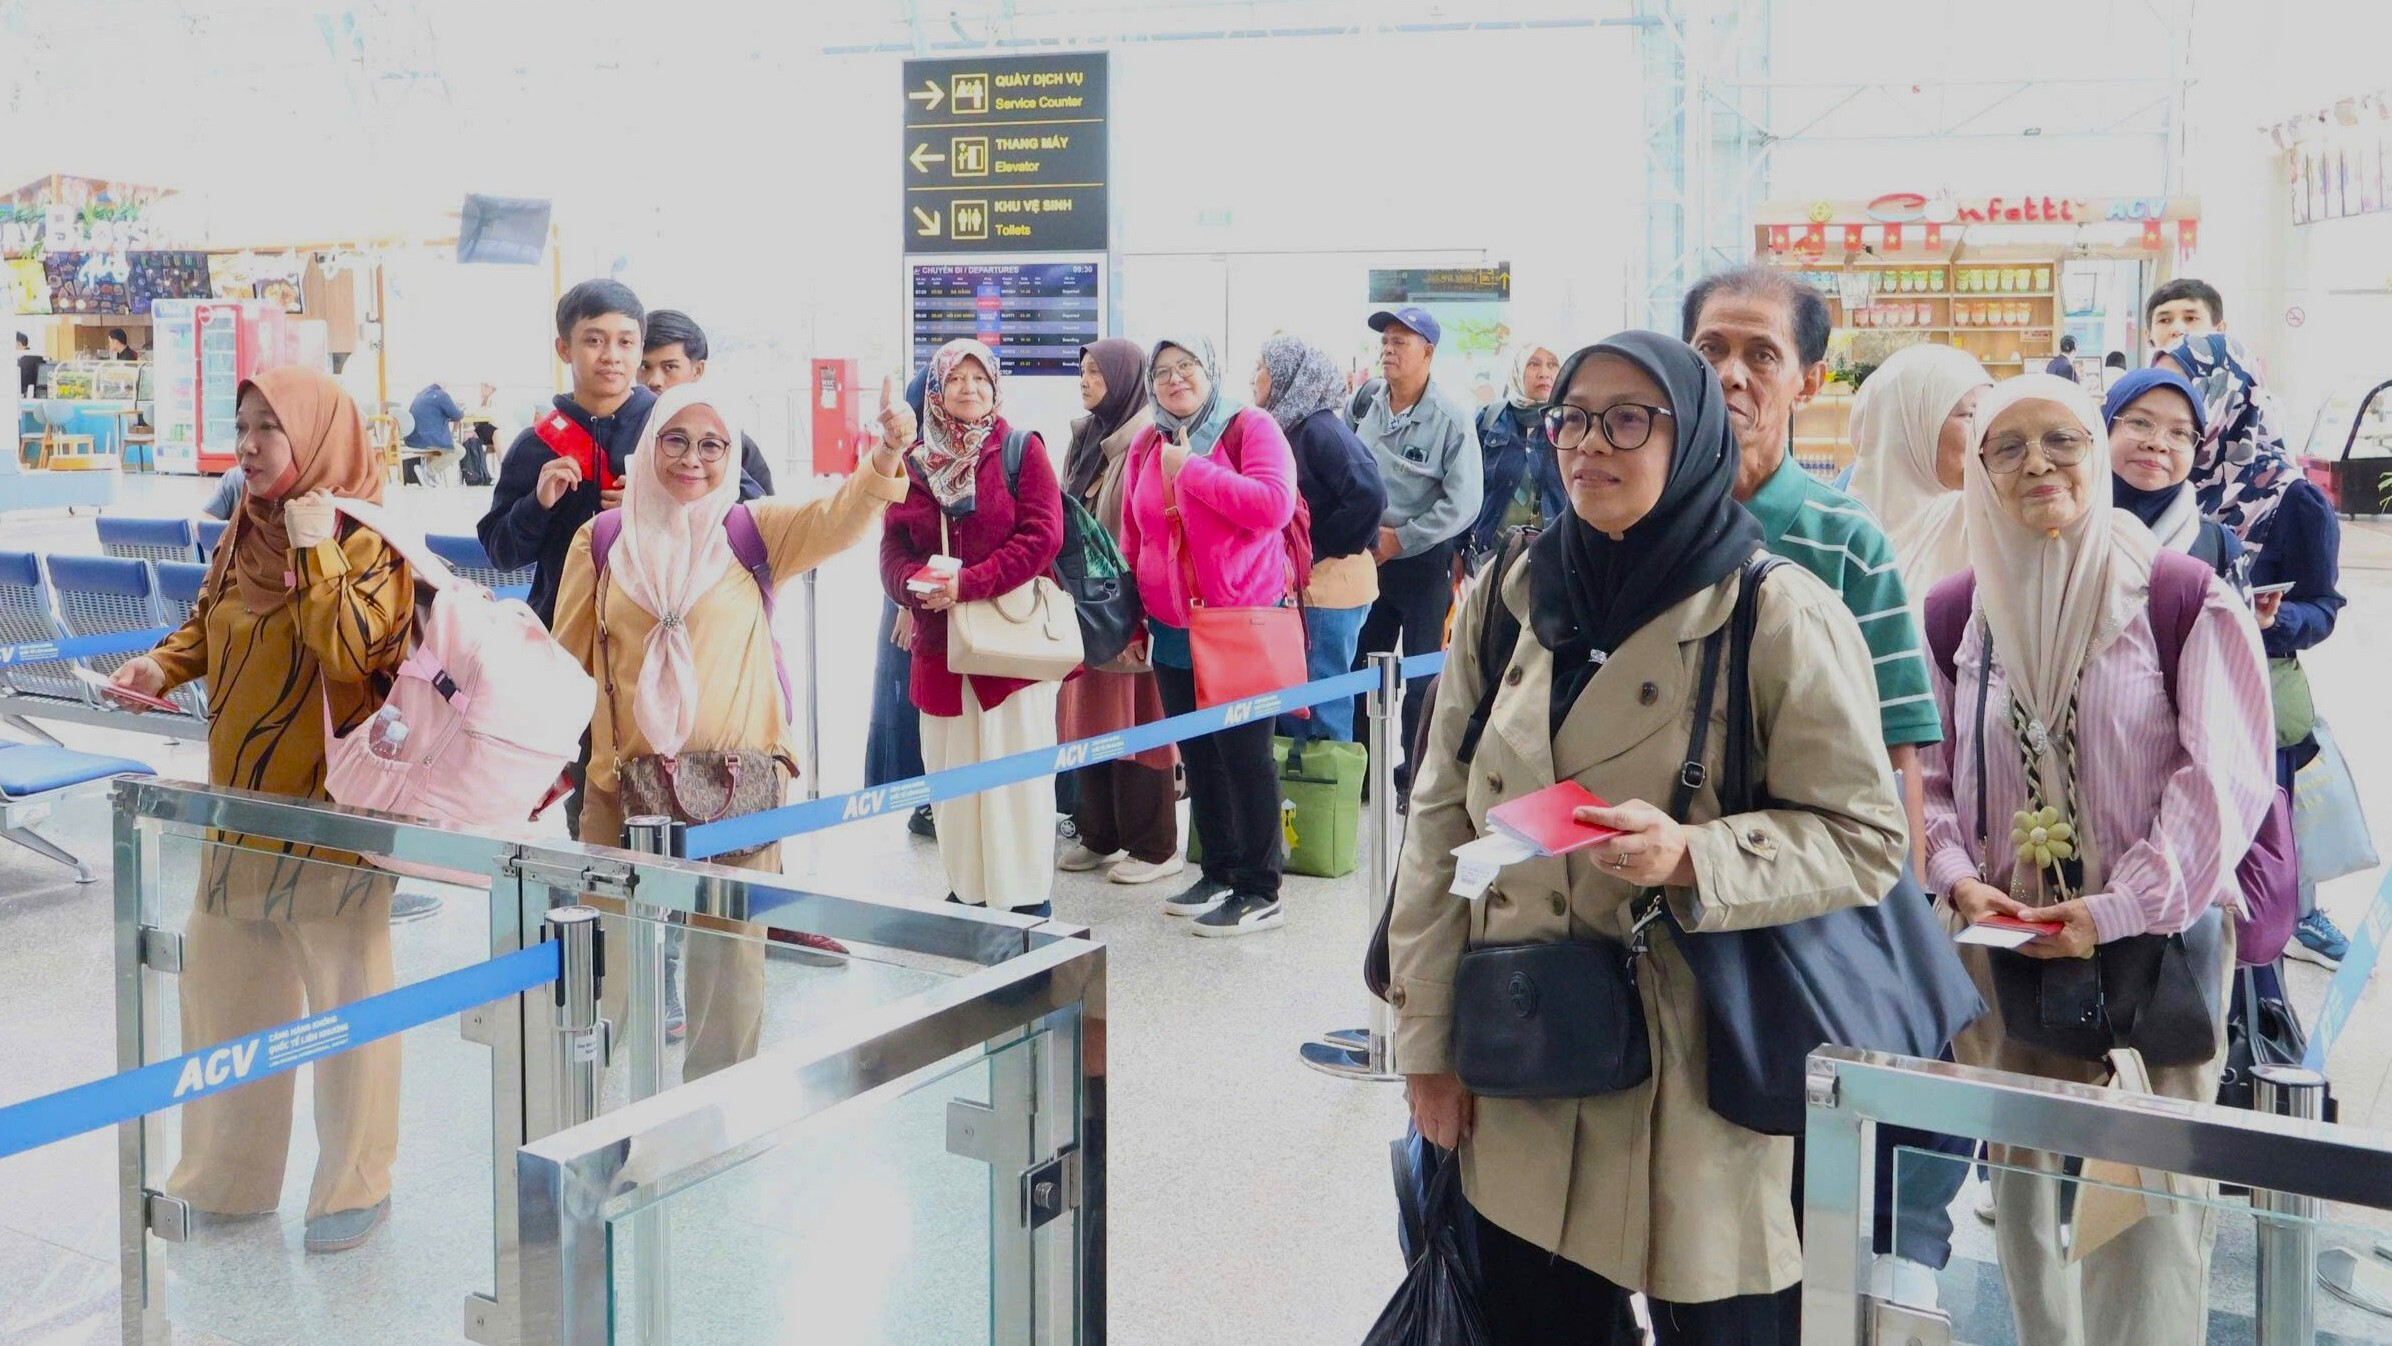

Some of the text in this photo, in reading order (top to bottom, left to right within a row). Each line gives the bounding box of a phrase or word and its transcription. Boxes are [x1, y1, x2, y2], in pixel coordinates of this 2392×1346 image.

[1065, 72, 1083, 86] VỤ
[995, 95, 1083, 110] Service Counter
[995, 134, 1069, 150] THANG MÁY
[995, 161, 1040, 173] Elevator
[994, 200, 1021, 212] KHU
[1042, 199, 1072, 211] SINH
[995, 224, 1031, 236] Toilets
[968, 266, 1019, 274] DEPARTURES
[1224, 700, 1252, 725] ACV
[1054, 742, 1088, 770] ACV
[842, 789, 886, 820] ACV
[172, 1038, 261, 1099] ACV
